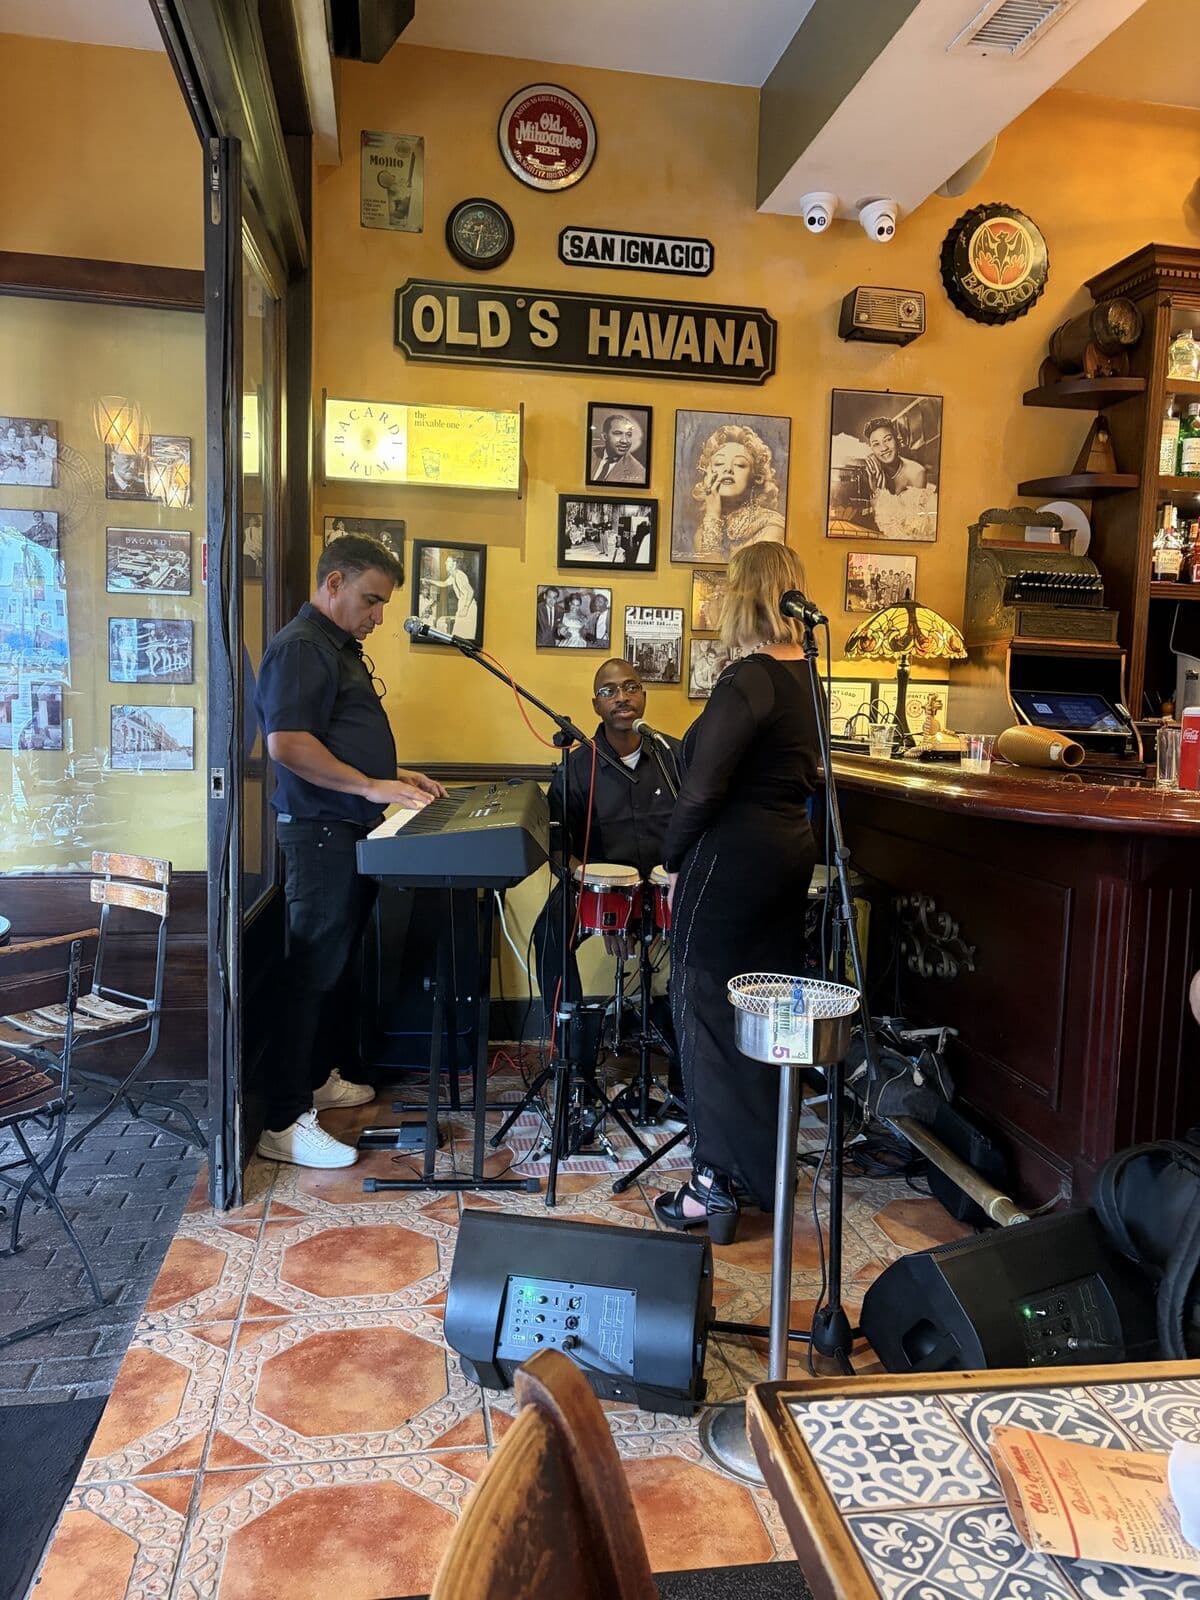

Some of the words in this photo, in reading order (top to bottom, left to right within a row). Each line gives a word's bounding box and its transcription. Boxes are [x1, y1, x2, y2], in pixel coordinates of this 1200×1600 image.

[540, 113, 561, 132] Old
[515, 120, 582, 149] Milwaukee
[535, 144, 561, 156] BEER
[370, 155, 404, 168] Mojito
[570, 235, 615, 261] SAN
[620, 239, 704, 269] IGNACIO
[961, 272, 1039, 306] BACARDI
[588, 307, 765, 368] HAVANA
[414, 411, 427, 419] the
[334, 406, 403, 444] BACARDI
[414, 419, 446, 429] mixable
[350, 460, 389, 476] RUM
[125, 537, 171, 546] BACARDI
[772, 1045, 790, 1058] 5
